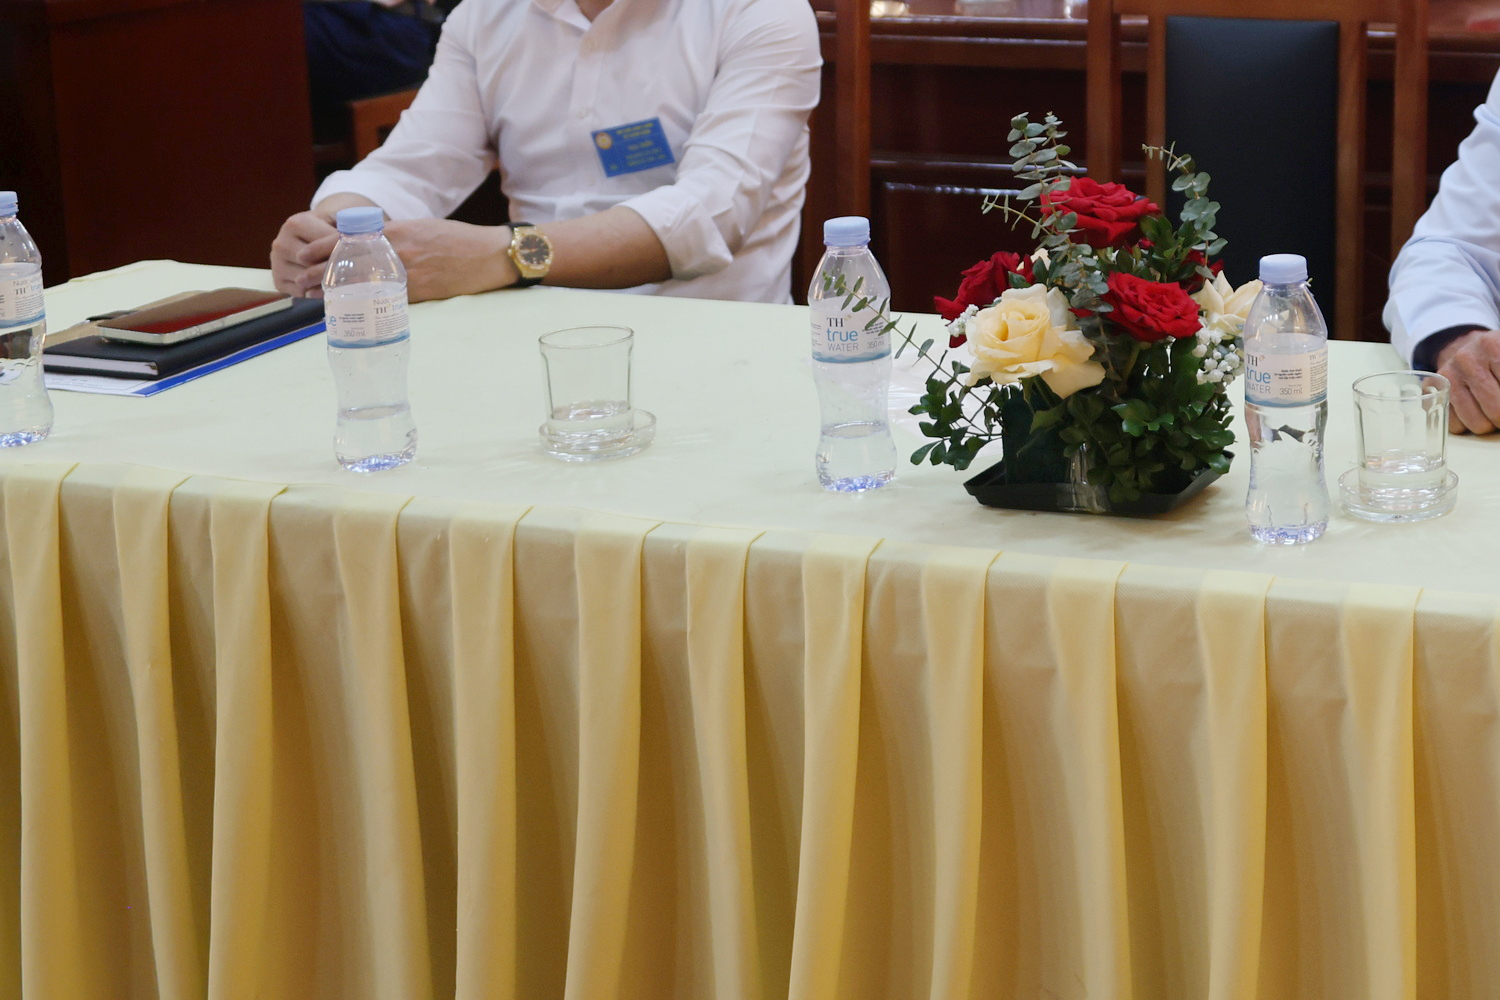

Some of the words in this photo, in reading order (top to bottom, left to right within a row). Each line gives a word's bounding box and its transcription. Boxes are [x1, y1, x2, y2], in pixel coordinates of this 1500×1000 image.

[827, 317, 844, 327] TH
[826, 328, 858, 342] true
[827, 342, 859, 352] WATER
[867, 340, 878, 349] 350
[1246, 353, 1258, 366] TH
[1246, 365, 1271, 384] true
